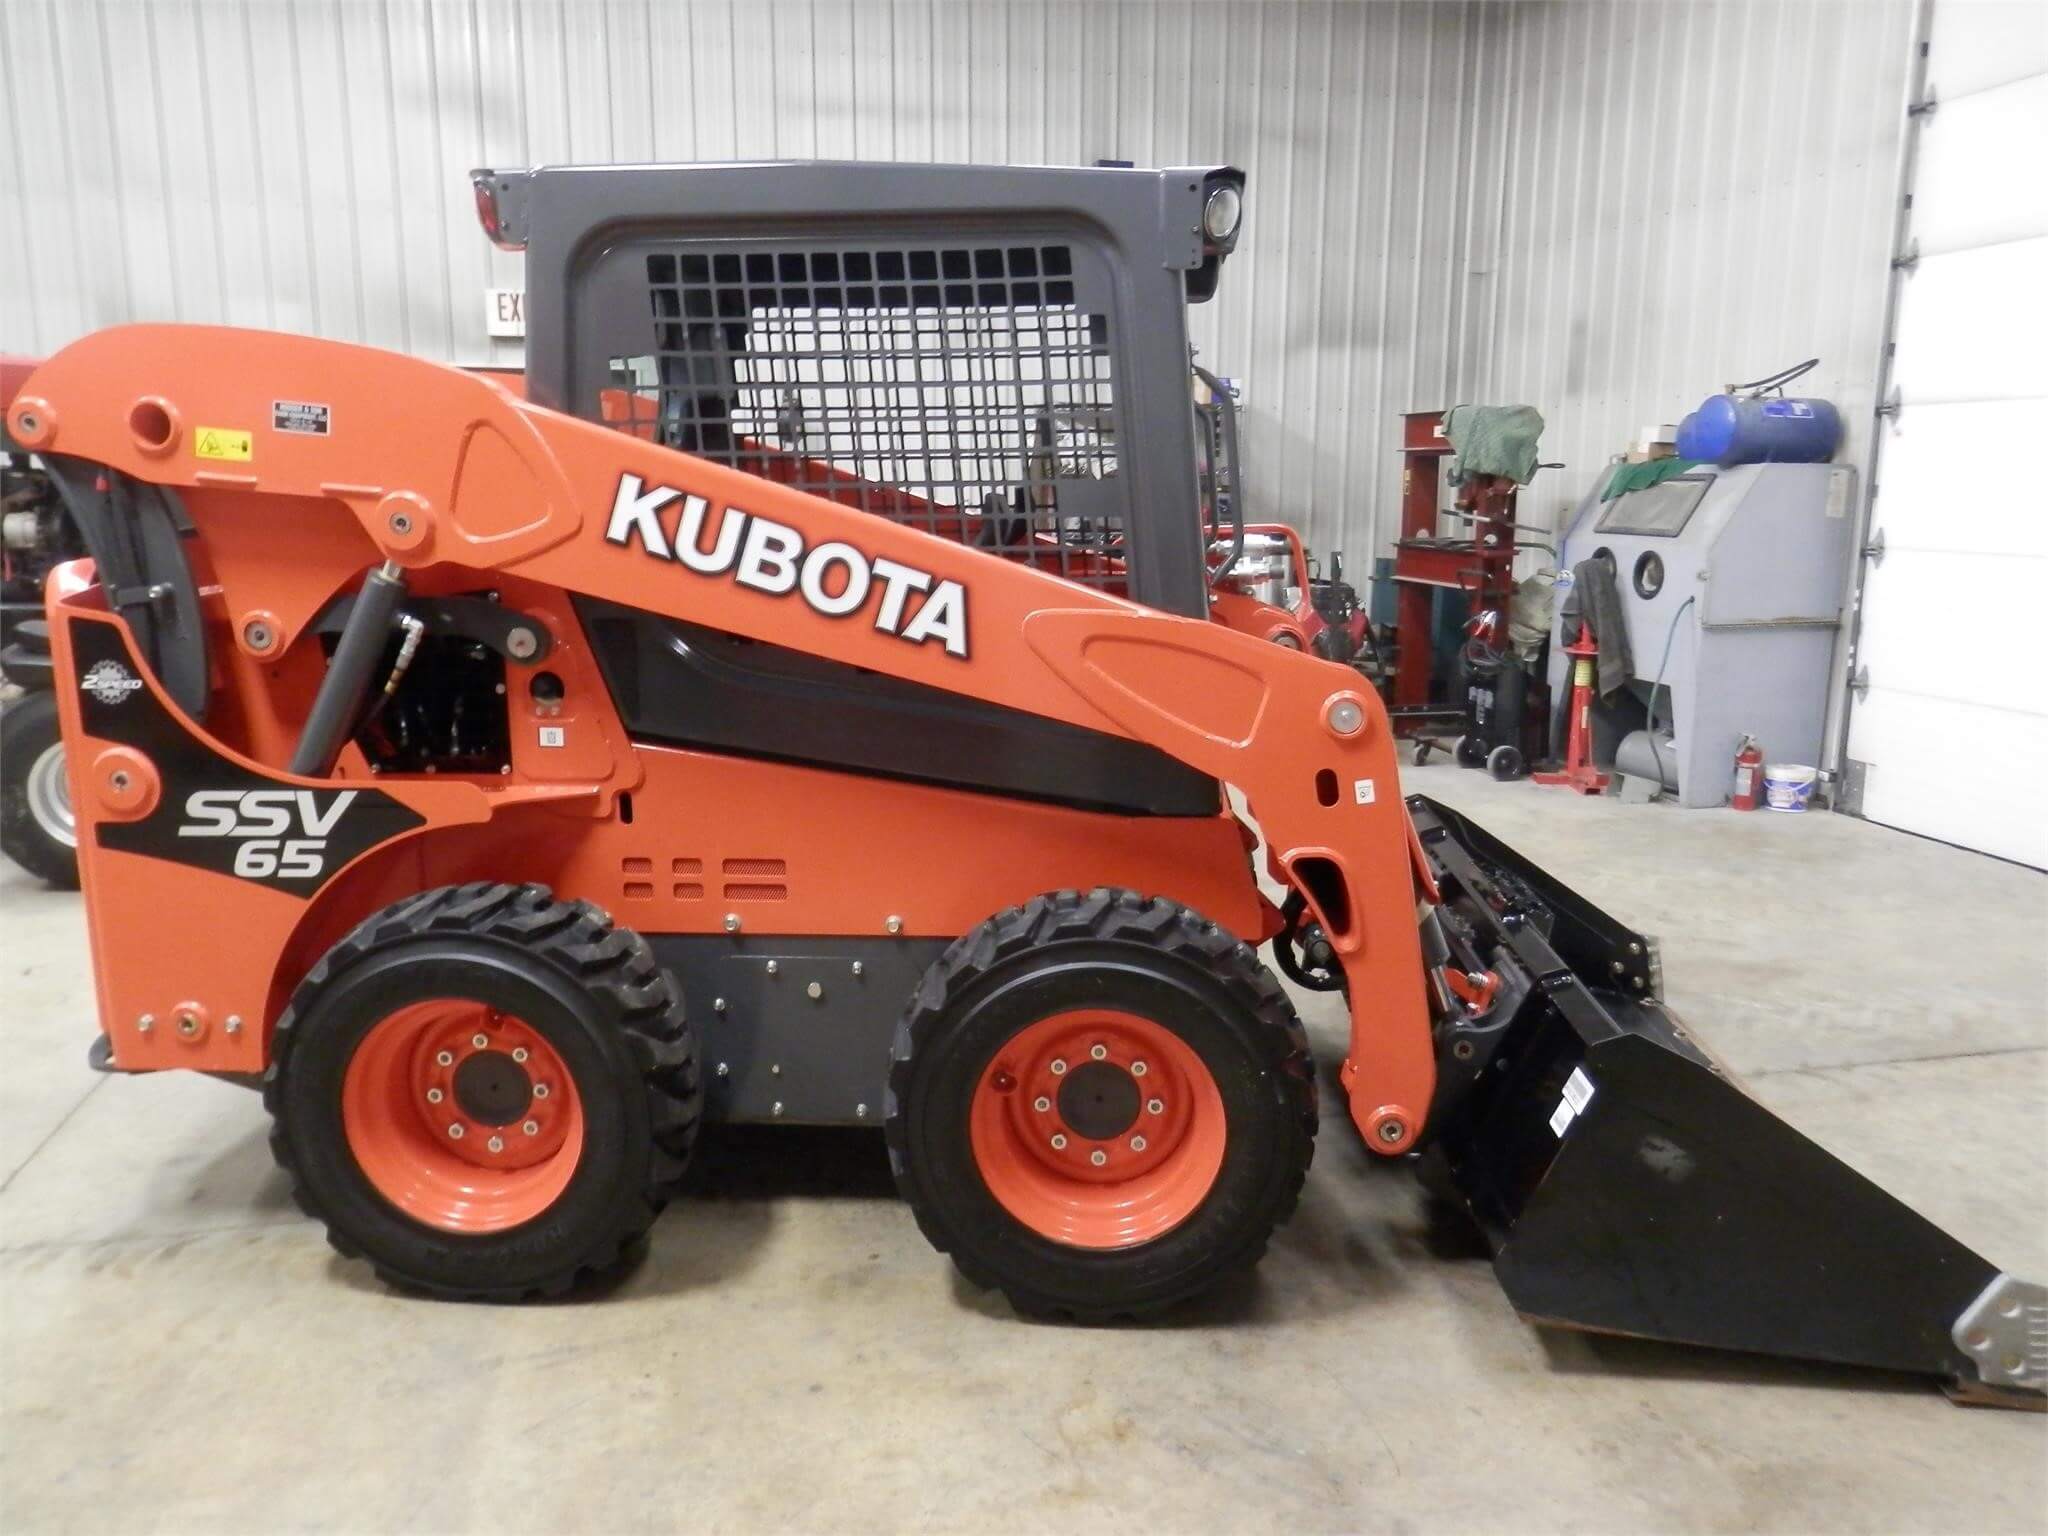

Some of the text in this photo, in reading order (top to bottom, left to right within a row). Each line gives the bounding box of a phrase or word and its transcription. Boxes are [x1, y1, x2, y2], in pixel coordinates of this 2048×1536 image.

[606, 472, 969, 657] KUBOTA
[178, 790, 359, 837] SSV
[234, 840, 327, 878] 65
